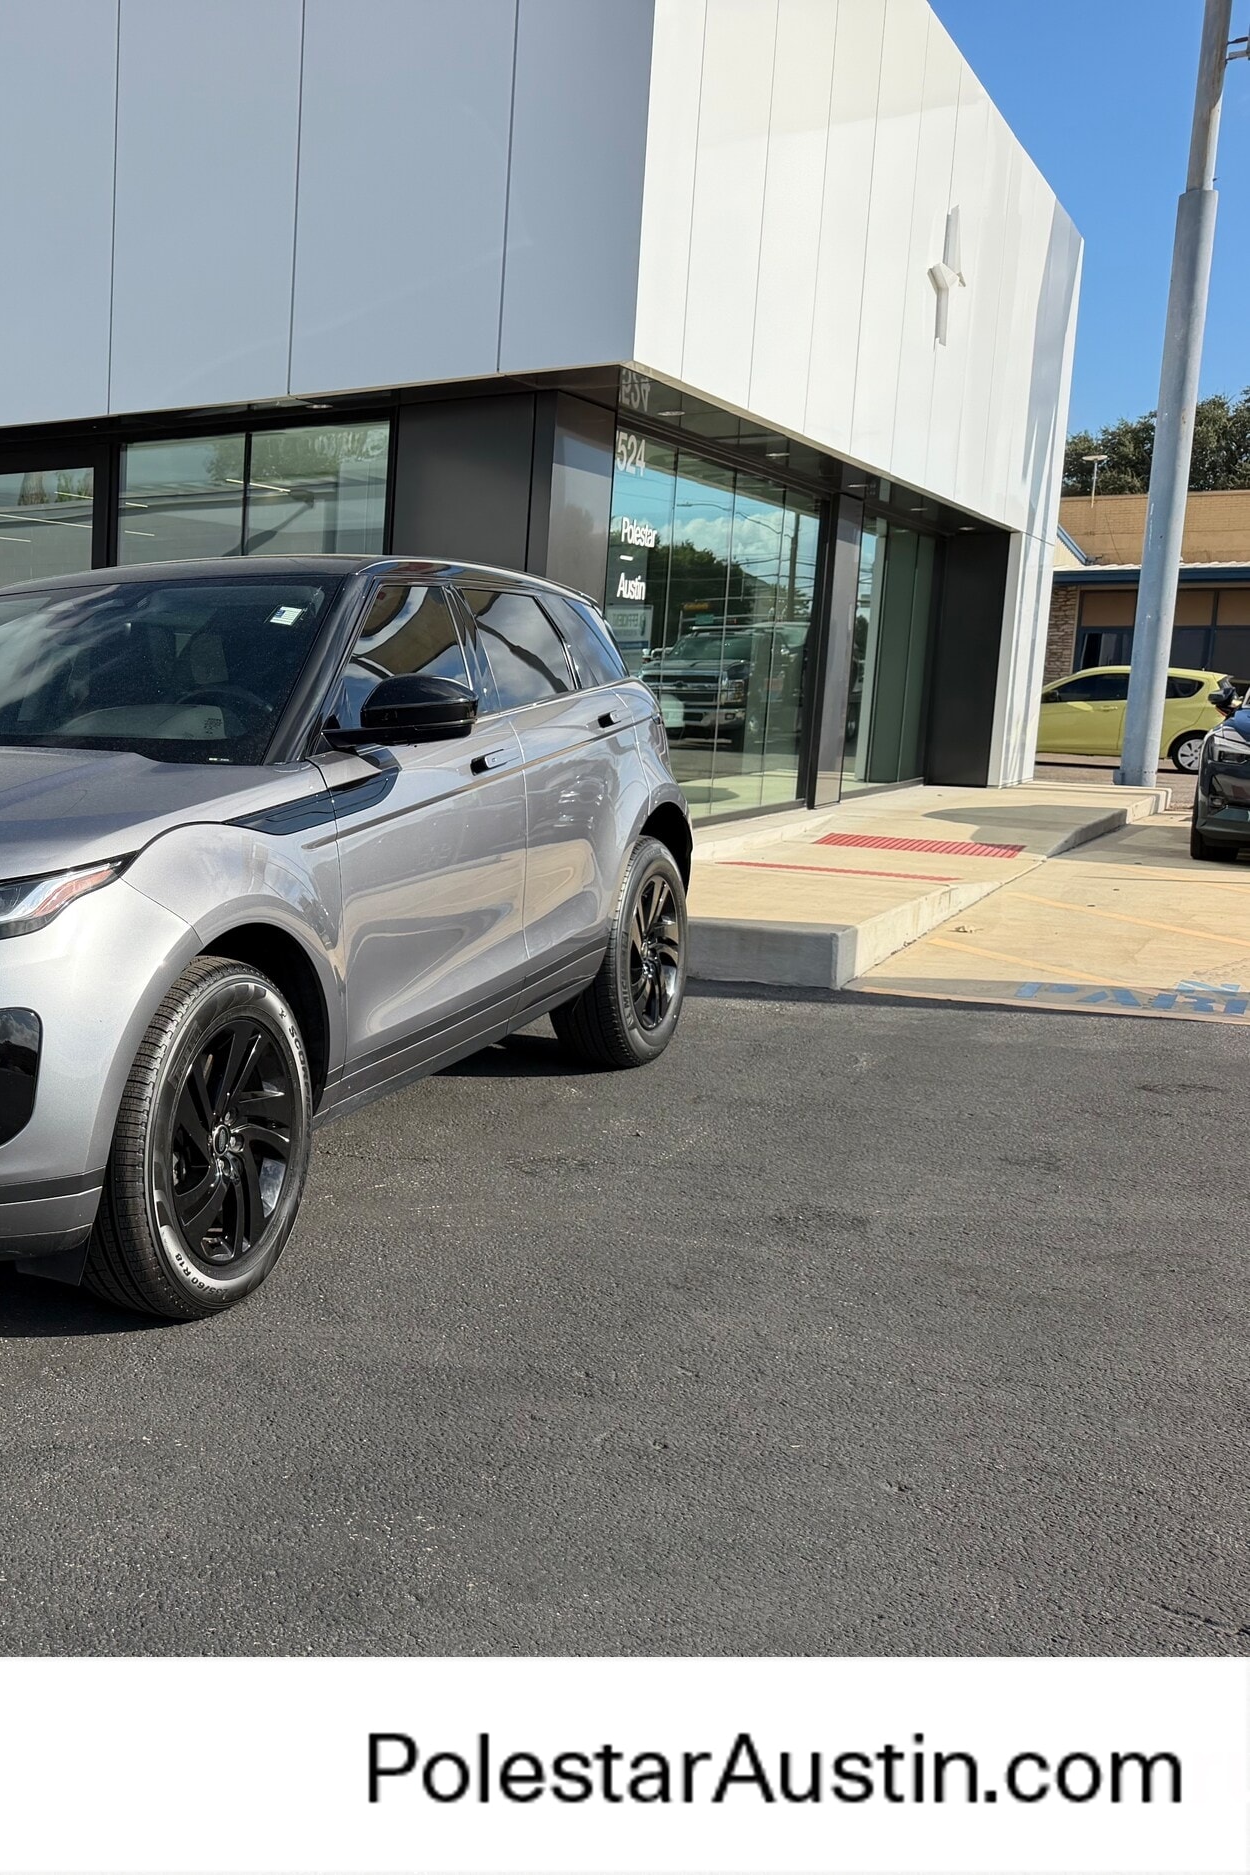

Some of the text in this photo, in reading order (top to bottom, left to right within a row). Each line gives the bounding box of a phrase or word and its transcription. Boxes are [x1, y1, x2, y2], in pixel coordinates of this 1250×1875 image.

[616, 430, 646, 477] 524
[620, 516, 658, 549] Polestar
[616, 571, 646, 602] Austin
